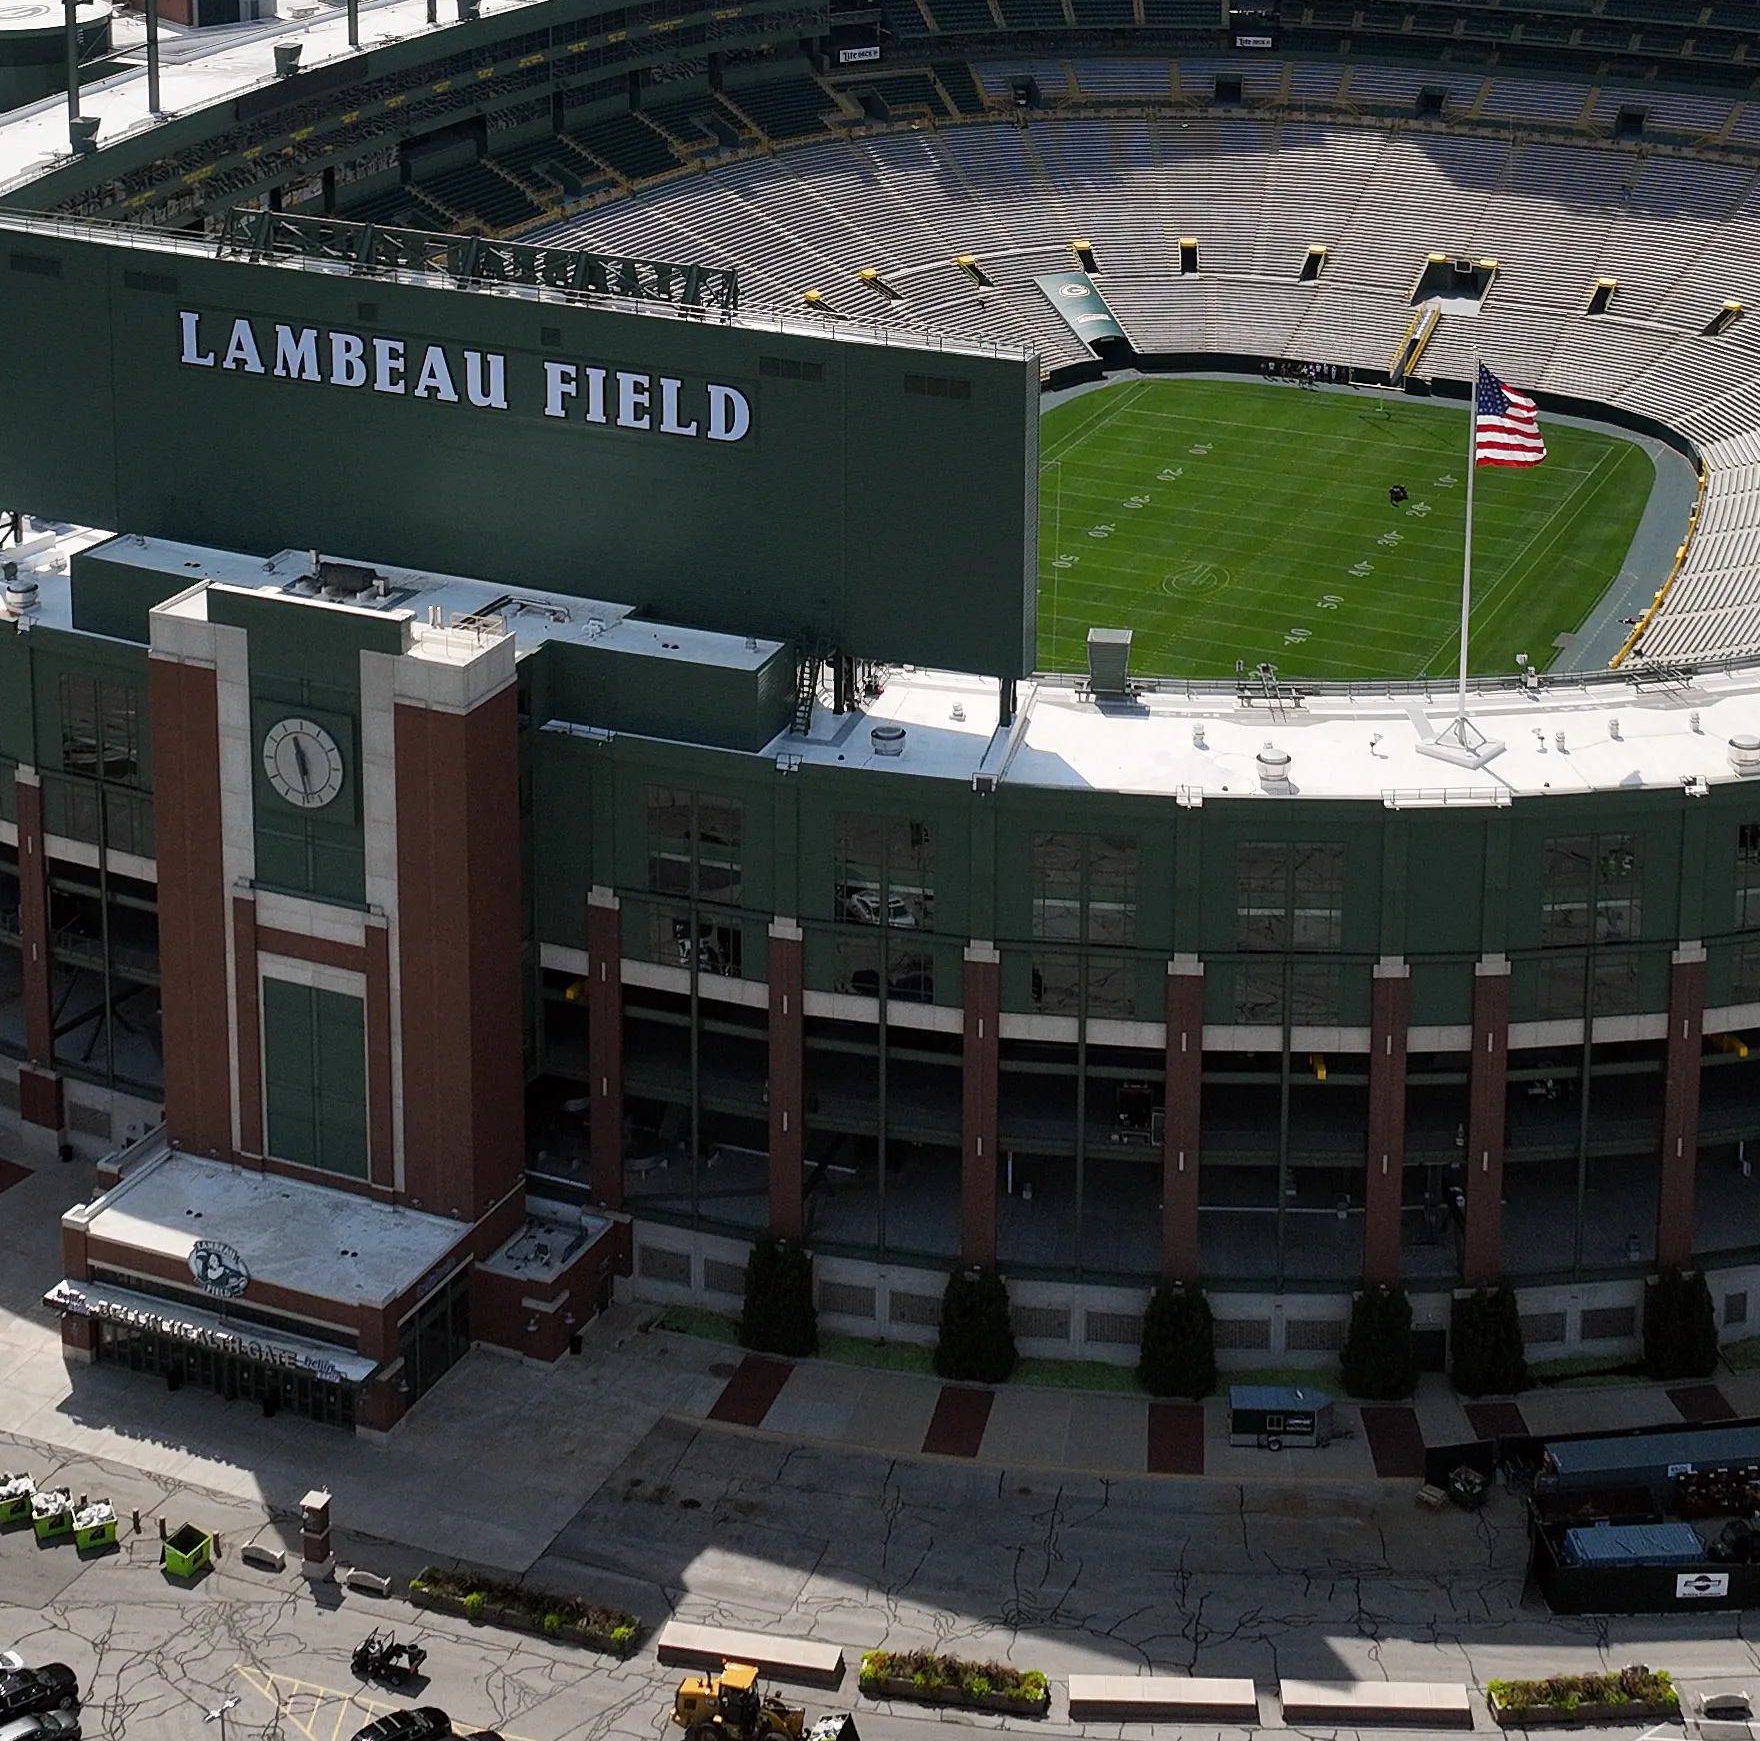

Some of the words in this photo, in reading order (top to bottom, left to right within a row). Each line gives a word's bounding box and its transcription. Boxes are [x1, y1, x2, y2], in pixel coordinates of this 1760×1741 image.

[178, 310, 509, 410] LAMBEAU
[543, 360, 751, 443] FIELD
[1188, 442, 1214, 456] 10
[1156, 466, 1184, 481] 20
[1434, 473, 1459, 489] 10
[1122, 493, 1152, 509] 30
[1405, 501, 1433, 519] 20
[1087, 523, 1116, 539] 40
[1377, 530, 1405, 548] 30
[1052, 553, 1081, 569] 50
[1347, 560, 1376, 579] 40
[1316, 594, 1345, 611] 50
[1284, 627, 1313, 647] 40
[195, 1239, 241, 1263] LAMBEAU
[204, 1283, 232, 1298] FIELD
[169, 1318, 241, 1357] HEALTH
[246, 1340, 299, 1369] GATE
